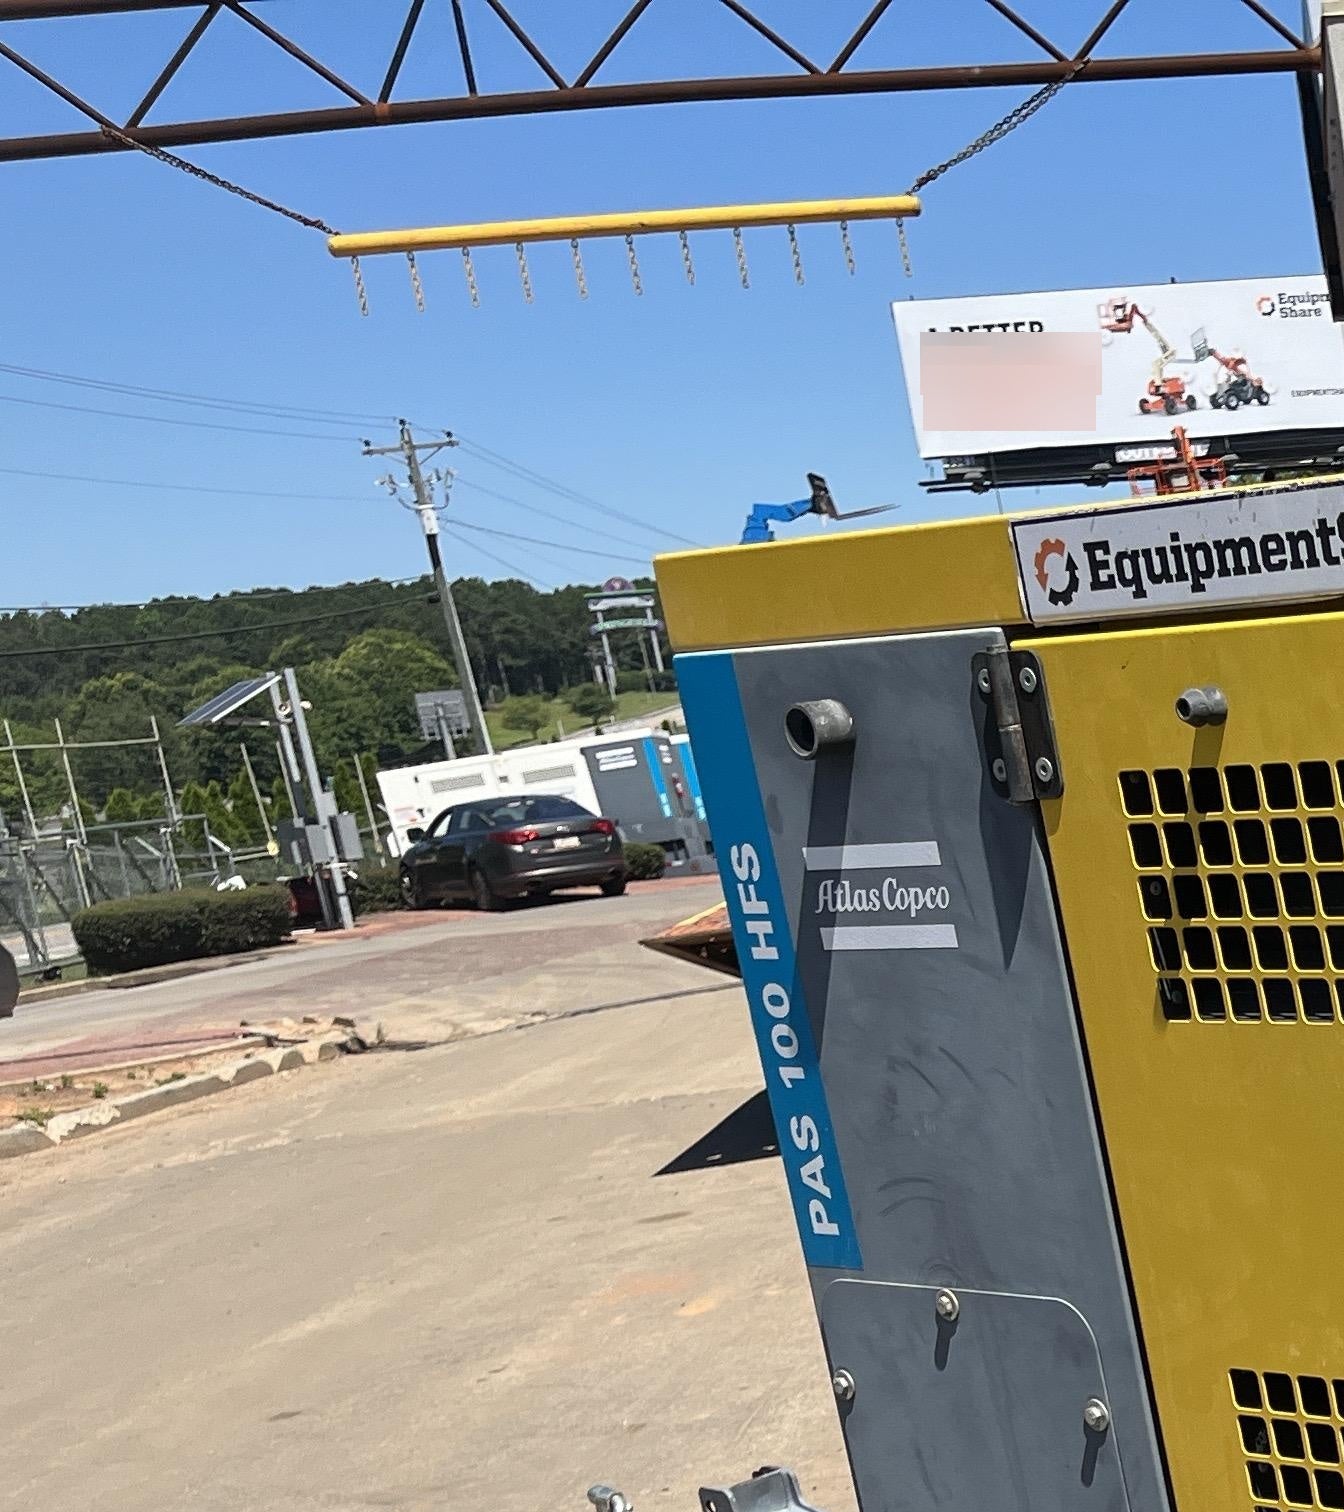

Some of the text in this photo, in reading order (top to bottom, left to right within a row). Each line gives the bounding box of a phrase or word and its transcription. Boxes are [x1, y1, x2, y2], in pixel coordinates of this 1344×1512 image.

[1280, 307, 1322, 318] Share
[816, 877, 951, 918] Atlas Copco
[730, 842, 839, 1237] PAS 100 HFS
